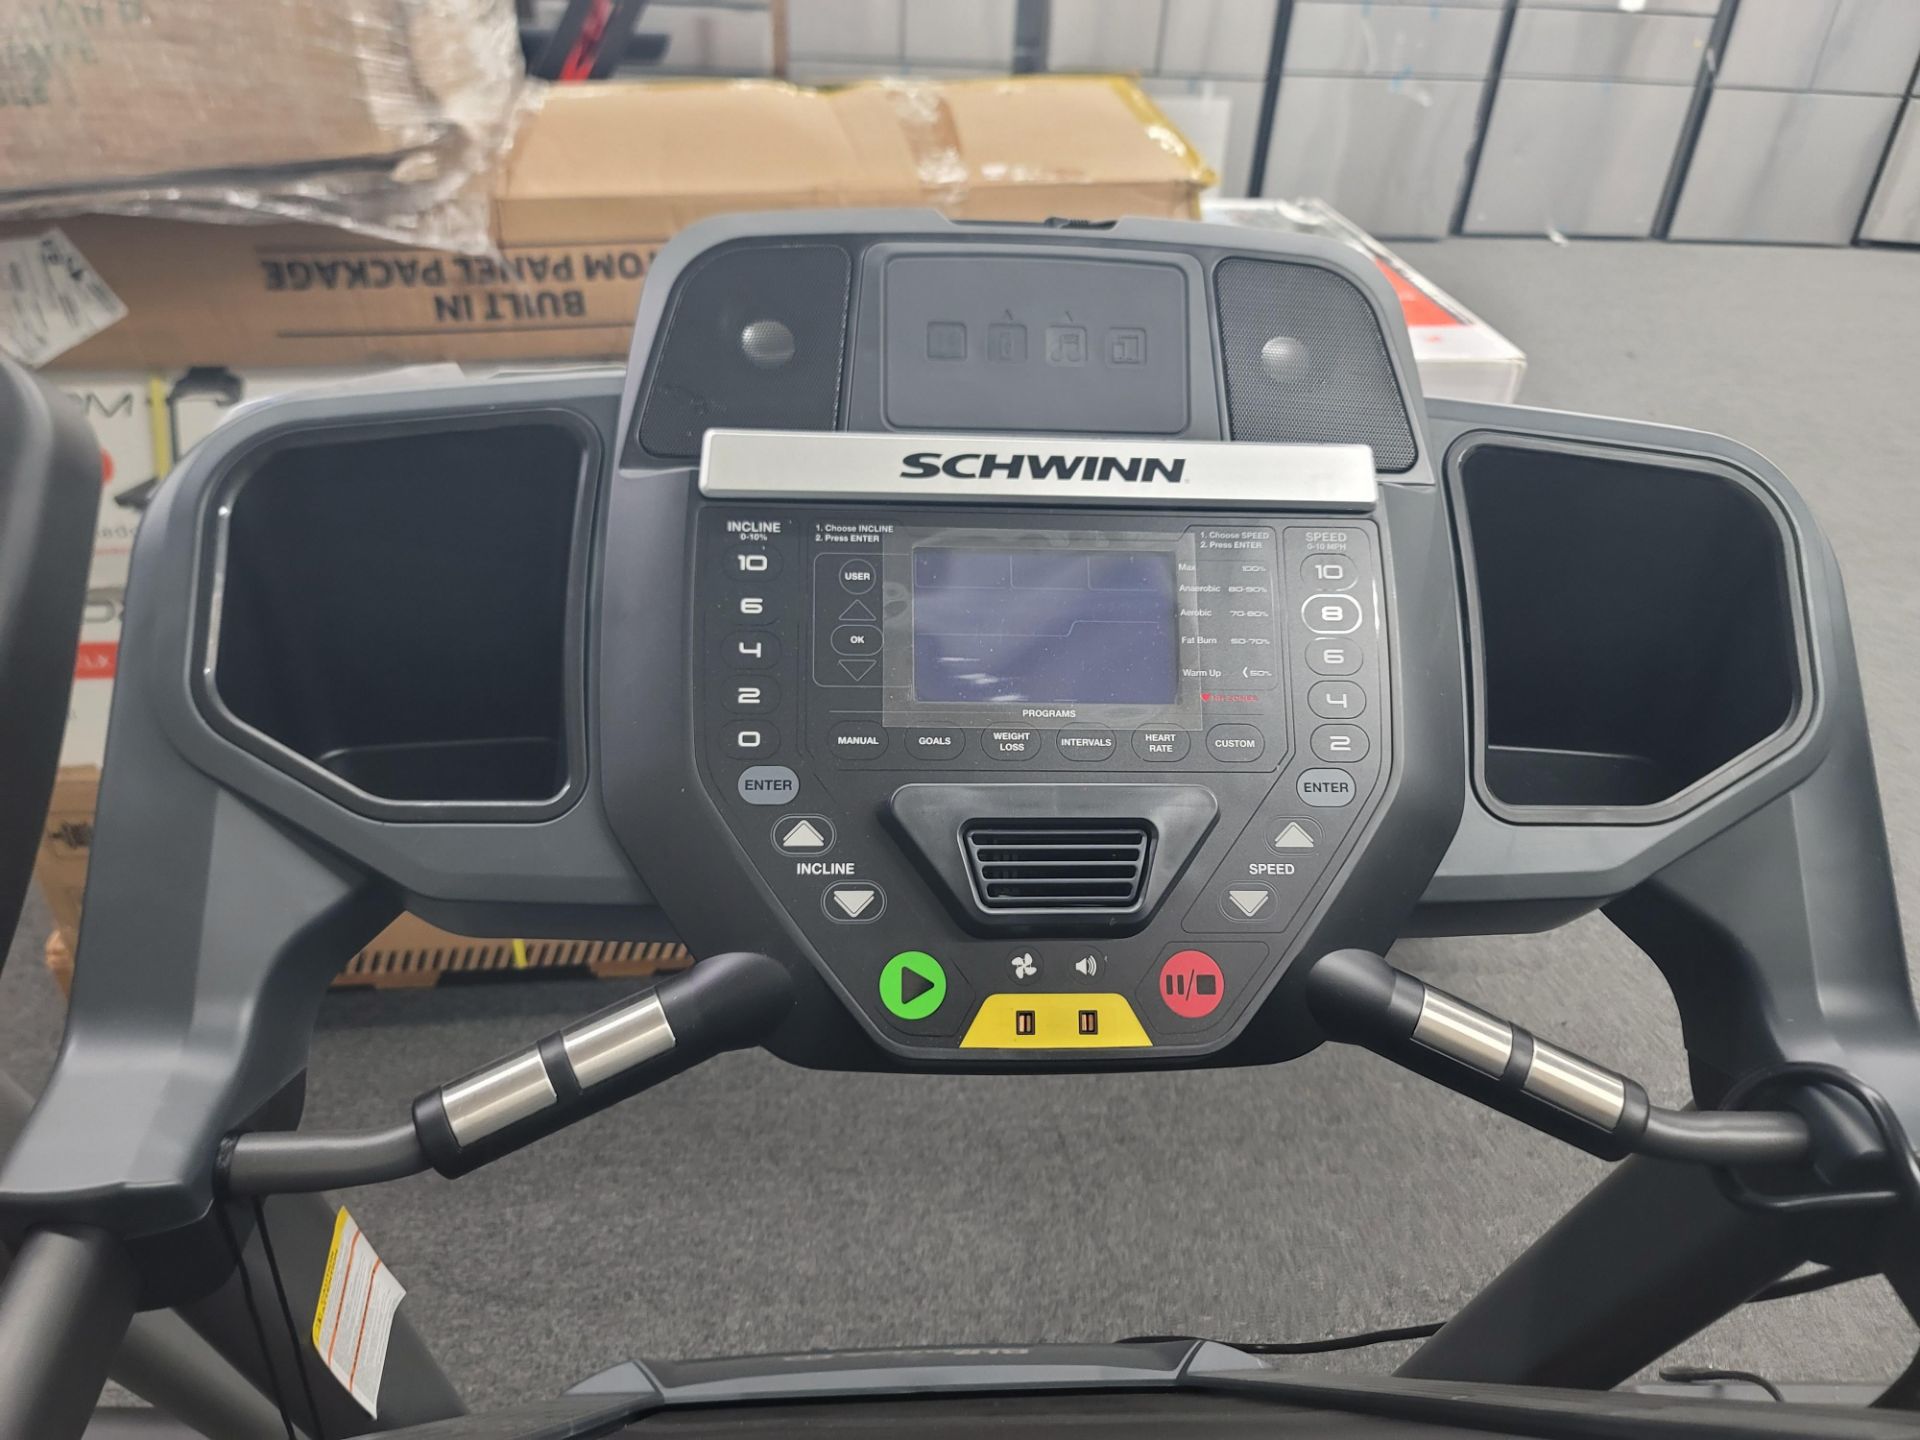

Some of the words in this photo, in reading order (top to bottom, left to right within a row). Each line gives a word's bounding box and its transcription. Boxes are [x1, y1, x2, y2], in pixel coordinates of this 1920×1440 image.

[454, 254, 573, 285] PANEL
[584, 253, 657, 283] OM
[262, 259, 445, 290] PACKAGE
[434, 295, 472, 322] IN
[484, 290, 585, 320] BUILT
[899, 453, 1185, 483] SCHWINN
[727, 521, 780, 532] INCLINE
[816, 524, 823, 532] 1.
[825, 524, 856, 532] Choose
[1306, 532, 1346, 542] SPEED
[737, 555, 767, 571] 10
[845, 573, 870, 581] USER
[1315, 565, 1343, 579] 10
[740, 598, 763, 614] 6
[1321, 606, 1343, 621] 8
[850, 636, 864, 644] OK
[1182, 636, 1195, 644] Fat
[739, 642, 762, 658] 4
[1323, 650, 1345, 664] 6
[1183, 669, 1207, 677] Warm
[1209, 669, 1221, 678] Up
[738, 688, 761, 703] 2
[1326, 693, 1347, 708] 4
[1023, 709, 1076, 718] PROGRAMS
[838, 737, 879, 745] MANUAL
[919, 737, 951, 745] GOALS
[993, 732, 1030, 741] WEIGHT
[1145, 734, 1176, 742] HEART
[999, 743, 1024, 751] LOSS
[1061, 738, 1111, 747] INTERVALS
[1215, 739, 1255, 748] CUSTOM
[1329, 736, 1351, 750] 2
[1149, 744, 1173, 753] RATE
[745, 780, 792, 791] ENTER
[1304, 783, 1348, 793] ENTER
[797, 863, 855, 875] INCLINE
[1249, 864, 1294, 875] SPEED
